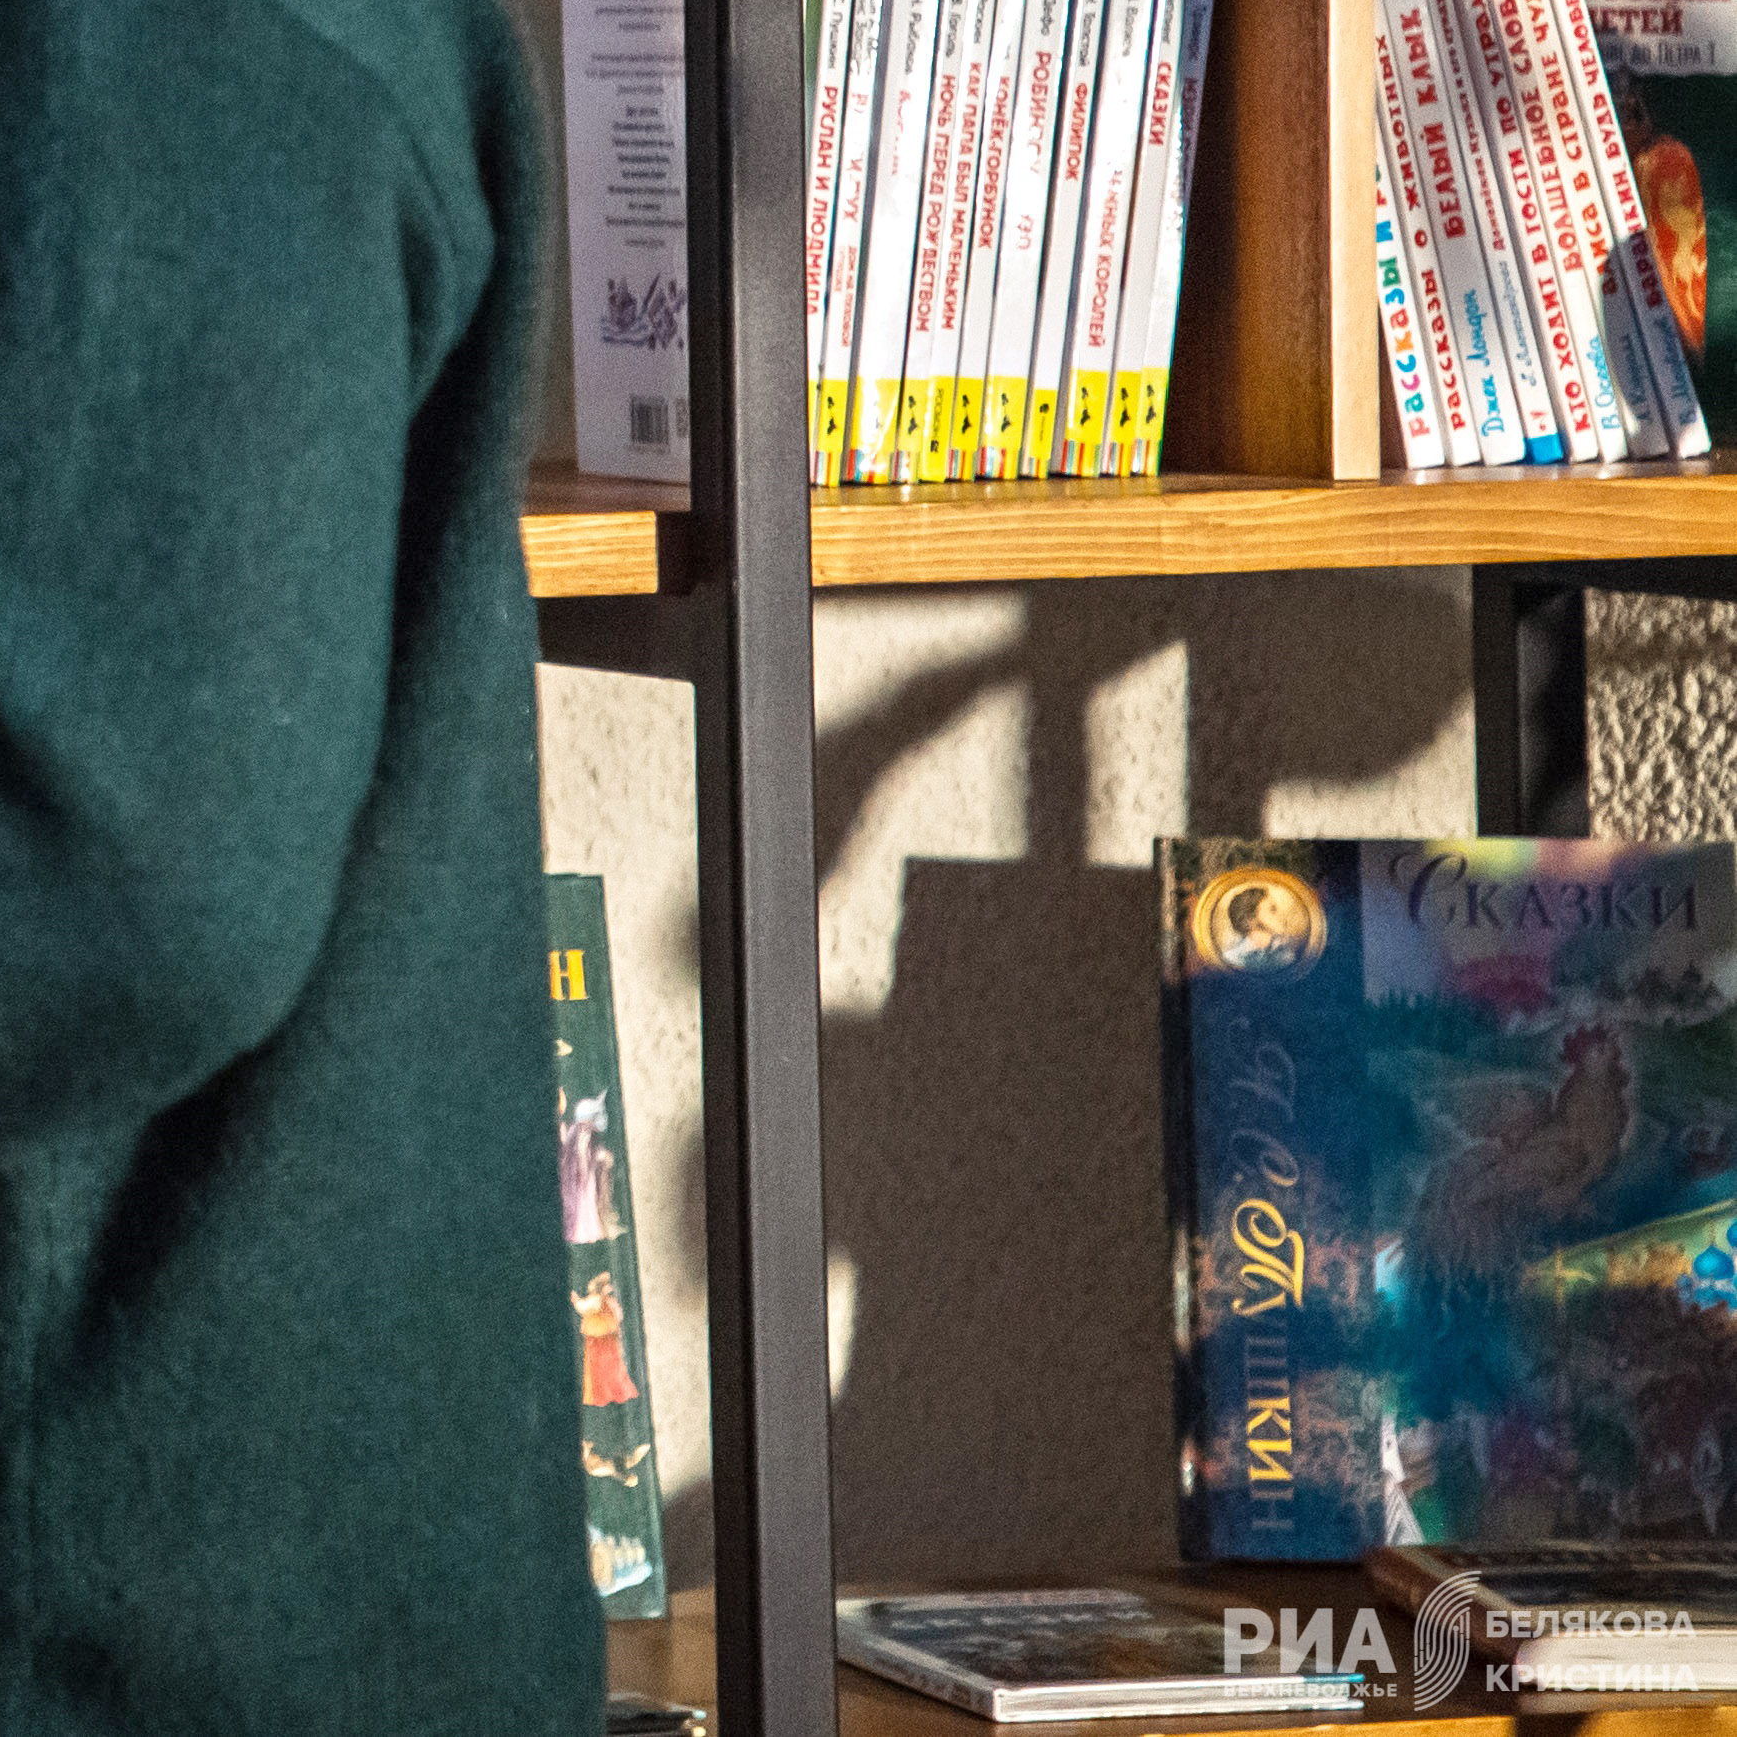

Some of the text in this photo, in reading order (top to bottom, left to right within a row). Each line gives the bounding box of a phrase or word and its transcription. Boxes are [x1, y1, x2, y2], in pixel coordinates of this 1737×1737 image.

[1147, 60, 1172, 145] СКАЗКИ
[1397, 6, 1439, 107] КЛЫК
[815, 85, 836, 169] РУСЛАН
[976, 75, 1011, 249] КОНЁК-ГОРБУНОК
[1063, 81, 1088, 181] ФИЛИПОК
[1590, 91, 1624, 160] БУДЬ
[813, 175, 829, 192] И
[913, 74, 955, 333] НОЧЬ ПЕРЕД РОЖДЕСТВОМ
[940, 62, 981, 330] КАК ПАПА БЫЛ МАЛЕНЬКИМ
[1418, 121, 1467, 240] БЕЛЫЙ
[1519, 86, 1584, 274] ВОЛШЕБНОЕ
[803, 198, 828, 316] ЛЮДМИЛА
[1087, 253, 1114, 348] КОРОЛЕЙ
[1494, 94, 1592, 433] КТО ХОДИТ В ГОСТИ ПО
[1452, 287, 1496, 370] Лондон
[1470, 373, 1506, 437] Джек
